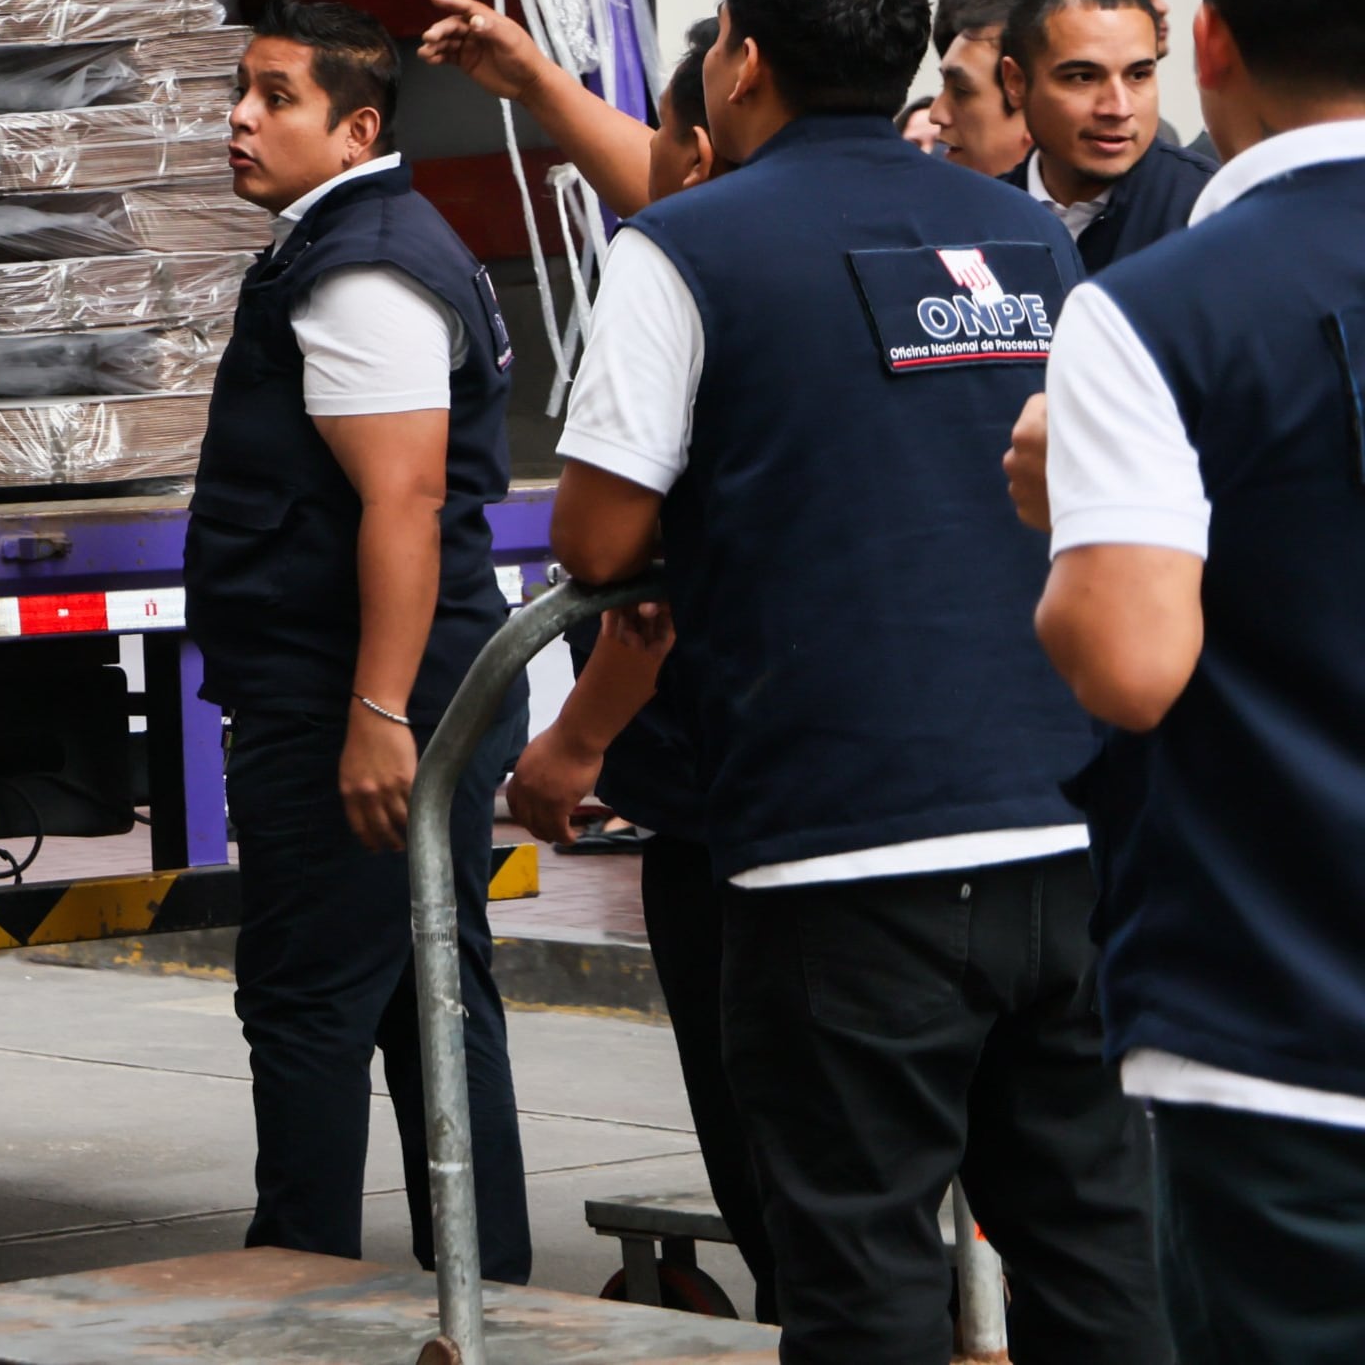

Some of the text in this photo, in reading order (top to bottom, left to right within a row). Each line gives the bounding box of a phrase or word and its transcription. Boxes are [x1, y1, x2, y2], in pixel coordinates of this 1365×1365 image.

[917, 293, 1053, 339] ONPE
[889, 344, 930, 360] Oficina
[930, 340, 979, 356] Nacional
[980, 339, 994, 351] de
[995, 339, 1038, 351] Procesos
